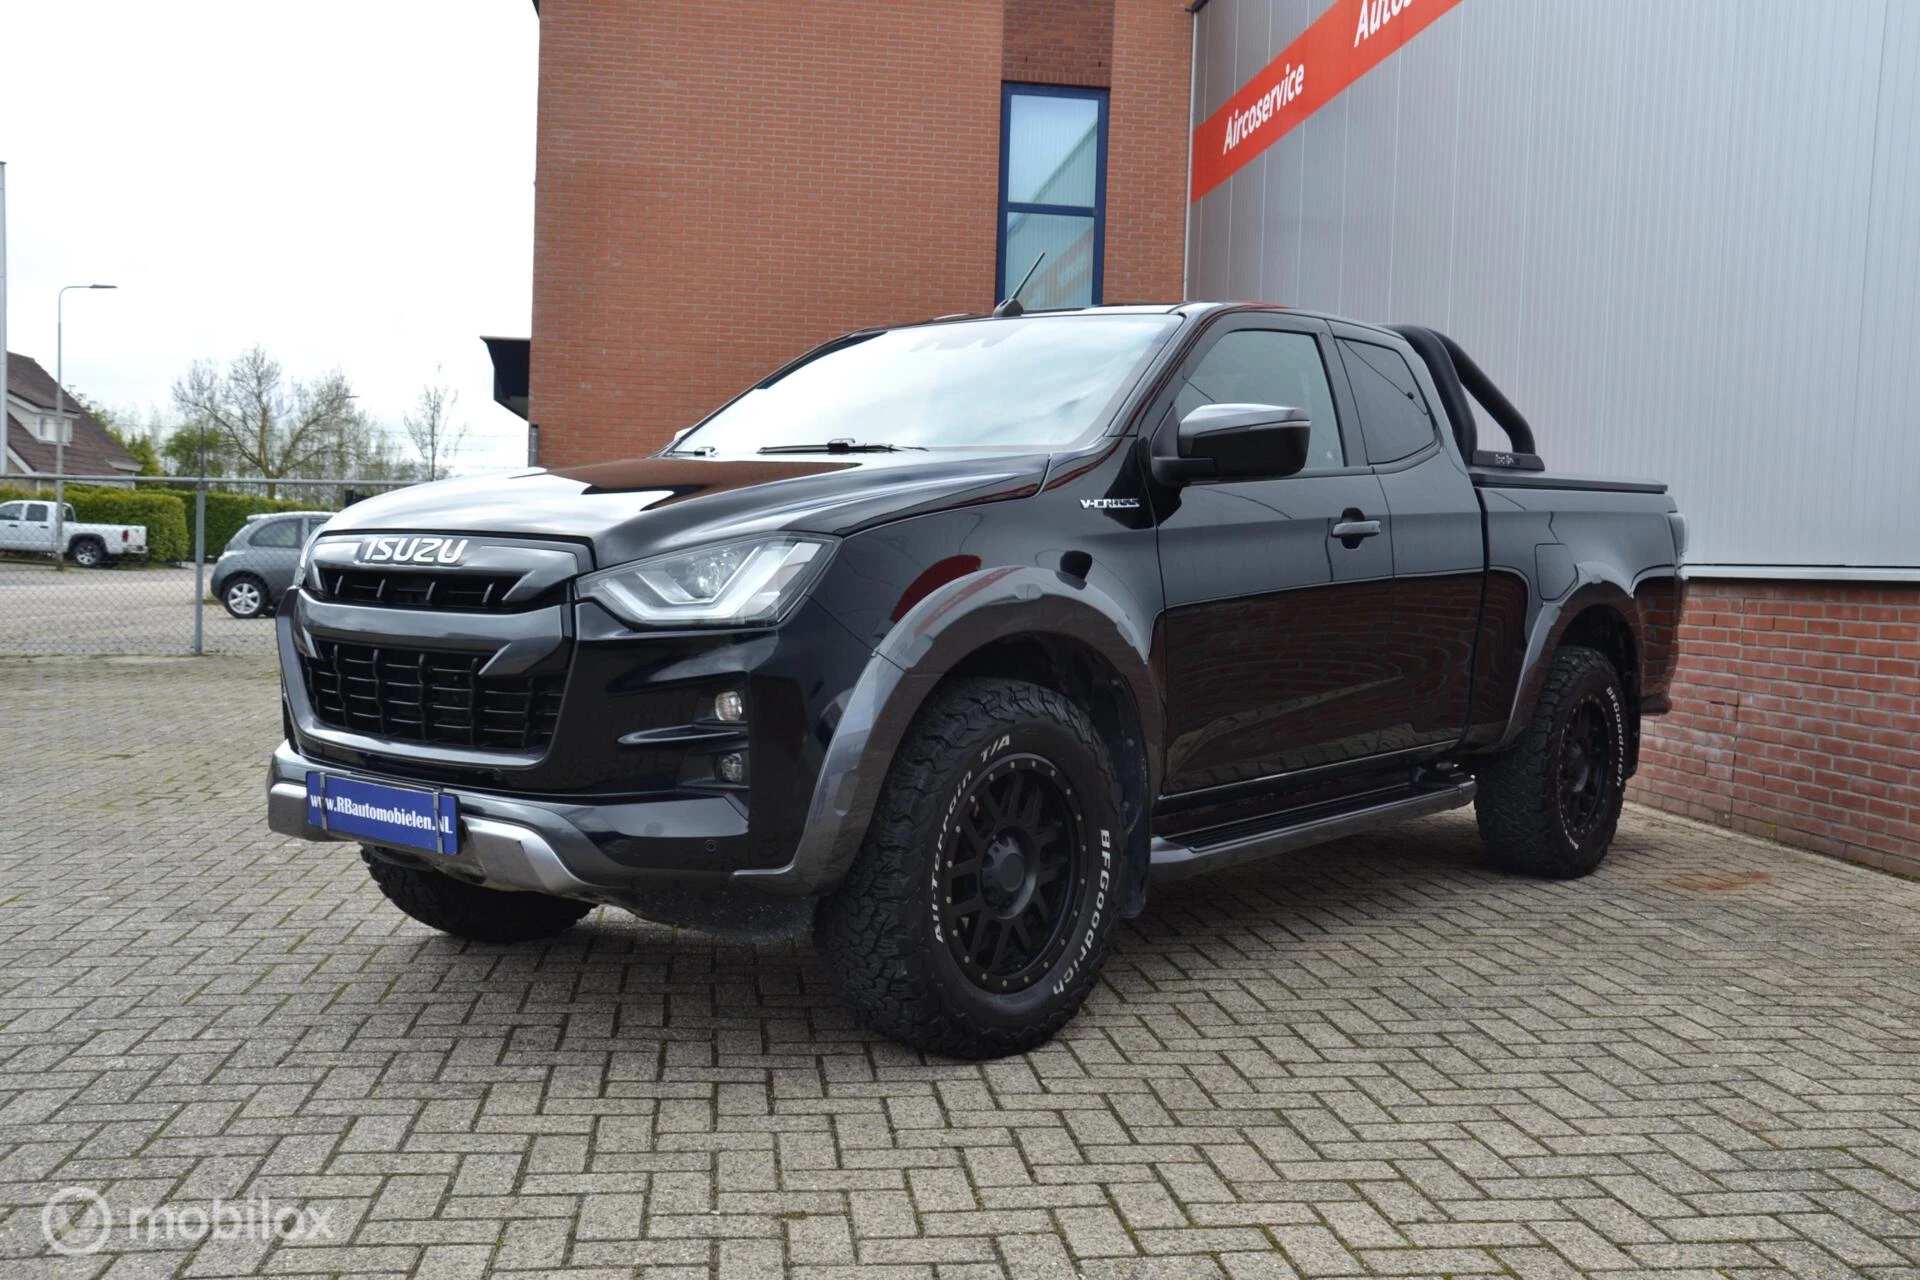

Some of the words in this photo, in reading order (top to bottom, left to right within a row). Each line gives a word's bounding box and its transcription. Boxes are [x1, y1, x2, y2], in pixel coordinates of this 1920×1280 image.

[1353, 0, 1412, 48] Auto
[1223, 63, 1305, 155] Aircoservice
[363, 537, 469, 564] ISUZU
[980, 733, 1011, 764] T/A
[1052, 828, 1111, 996] BFGoodrich
